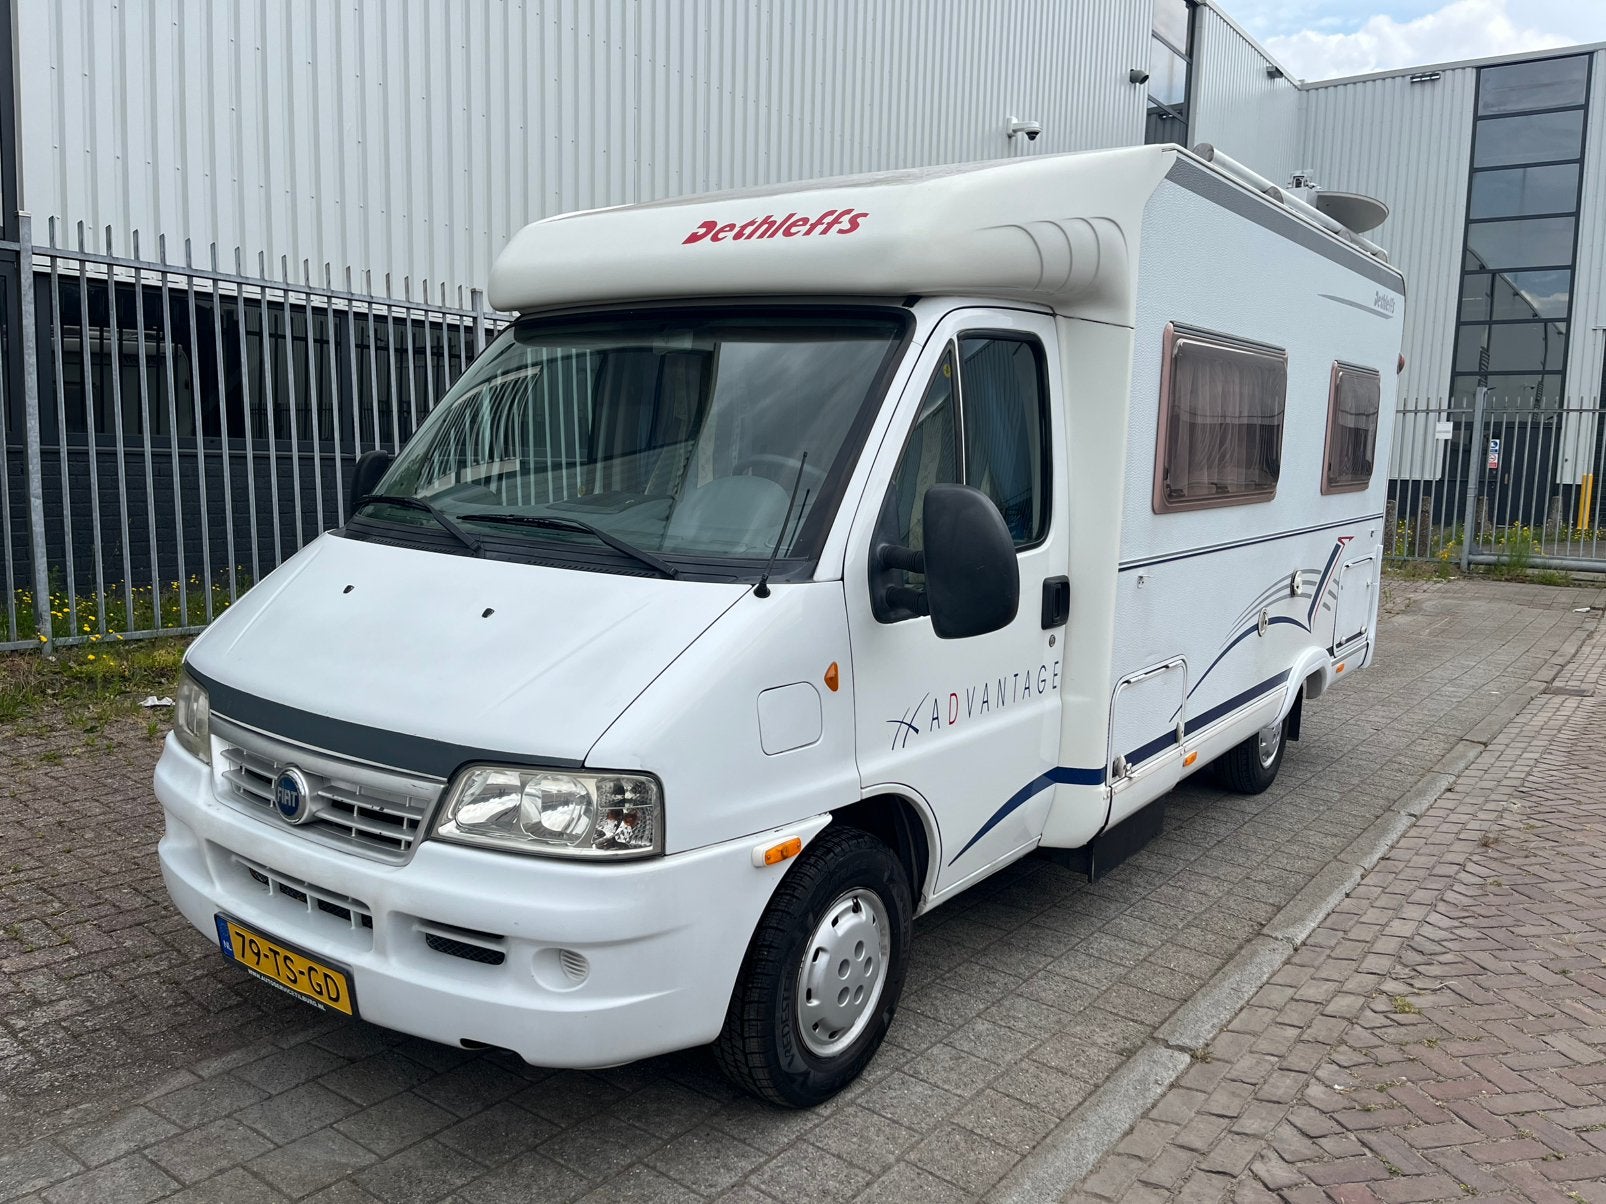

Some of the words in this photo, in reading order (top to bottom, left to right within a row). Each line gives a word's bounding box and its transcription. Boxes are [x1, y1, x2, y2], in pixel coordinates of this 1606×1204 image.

[681, 208, 869, 245] Dethleffs
[930, 661, 1059, 732] ADVANTAGE
[277, 786, 298, 808] FIAT
[234, 930, 341, 1003] 79-TS-GD
